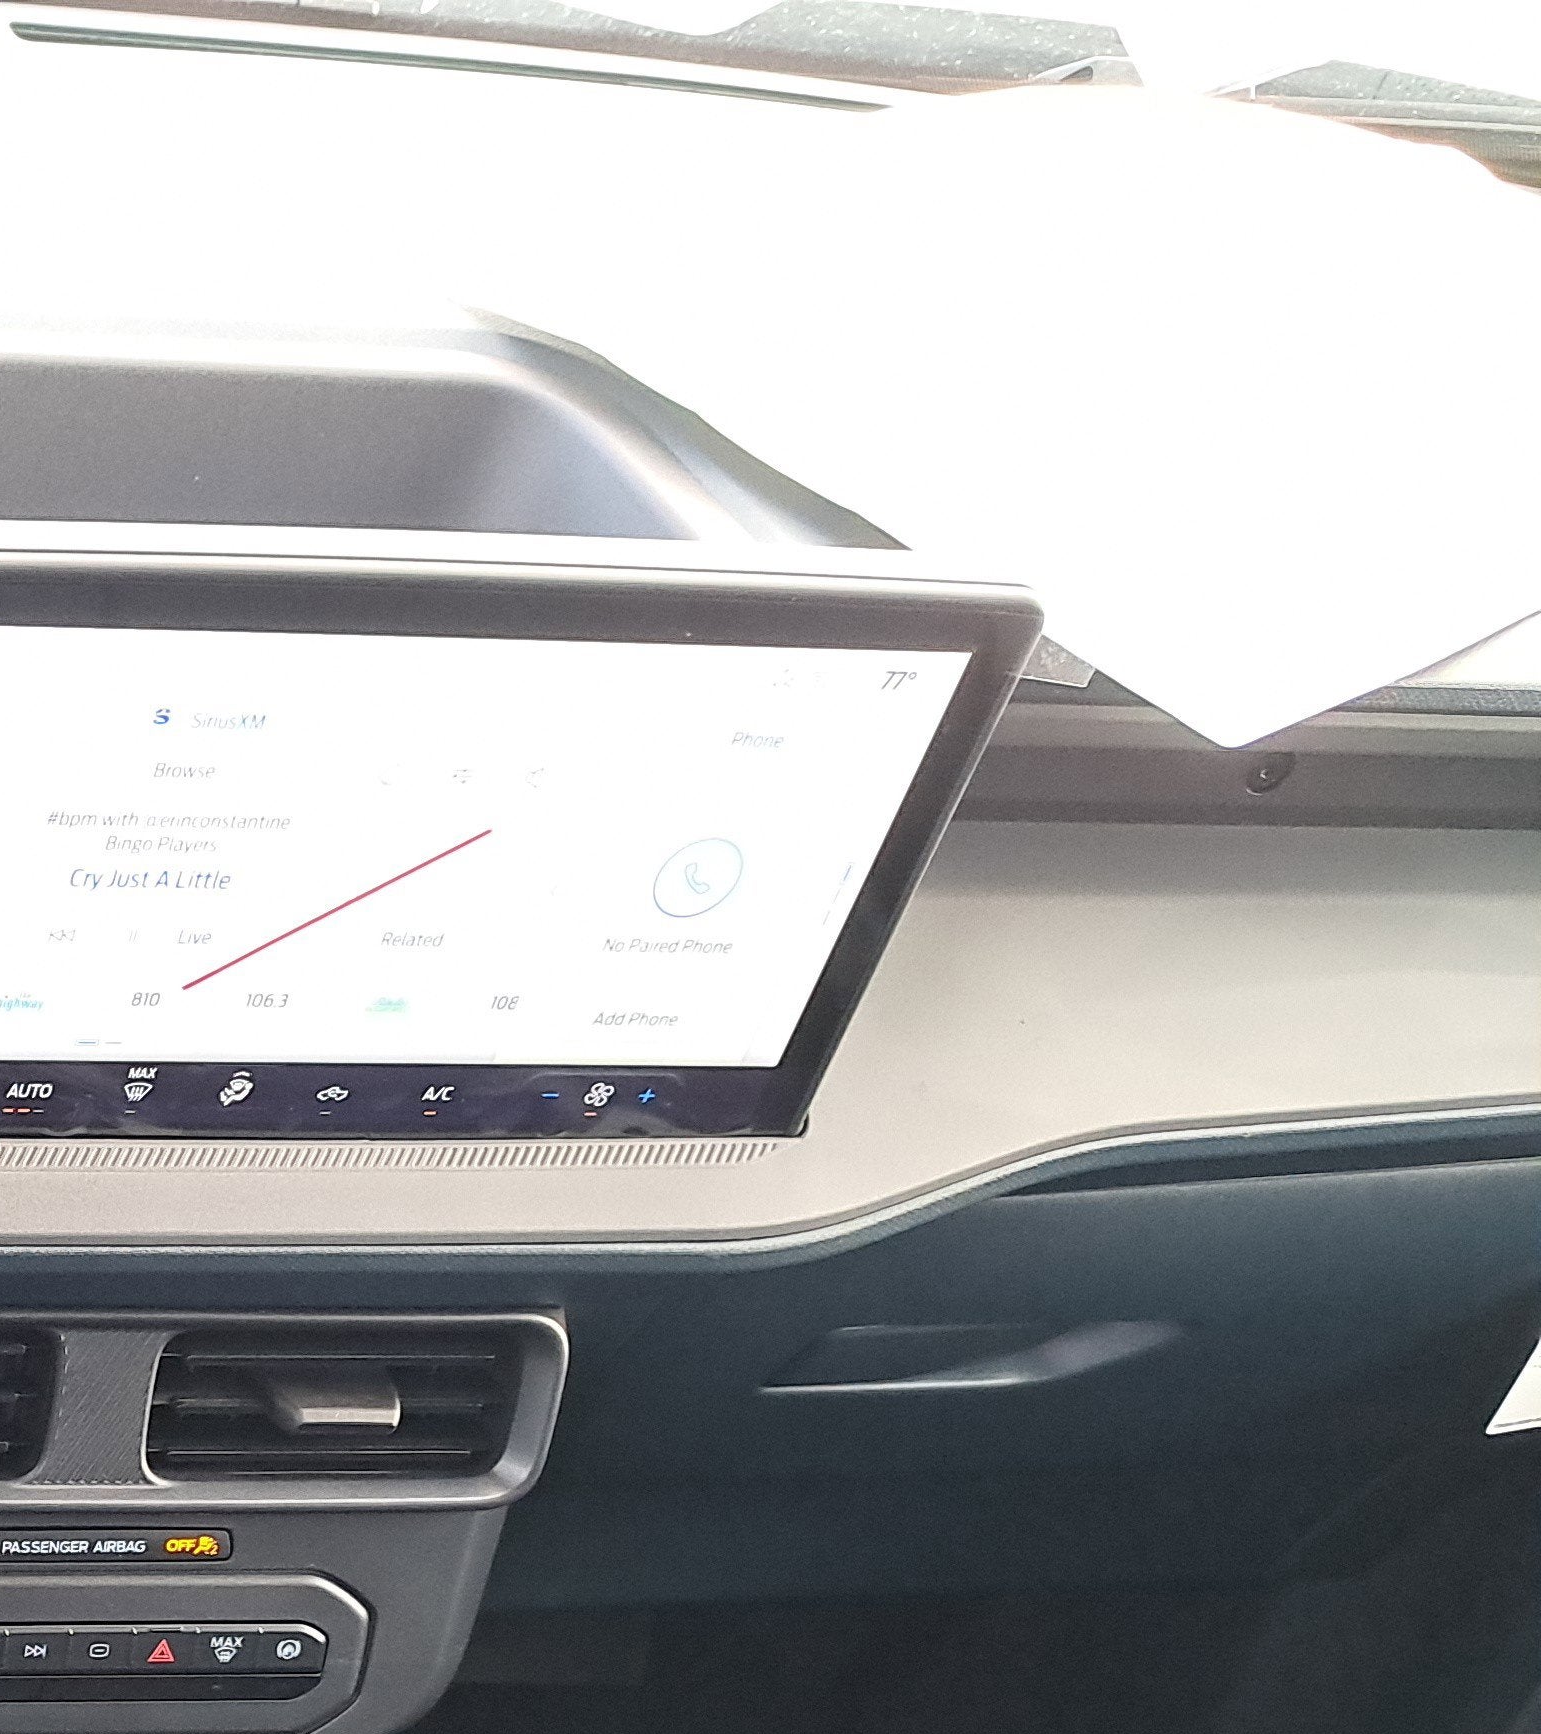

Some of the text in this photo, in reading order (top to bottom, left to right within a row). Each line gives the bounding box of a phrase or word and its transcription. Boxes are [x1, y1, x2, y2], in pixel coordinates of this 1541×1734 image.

[190, 712, 267, 731] SiriusXM
[731, 731, 784, 749] Phone
[152, 762, 216, 779] Browse
[46, 810, 99, 832] #bpm
[102, 812, 139, 830] with
[104, 835, 217, 854] Bingo Players
[69, 868, 232, 891] Cry Just A Little
[177, 927, 213, 946] Live
[380, 931, 445, 948] Related
[601, 938, 734, 956] No Paired Phone
[130, 991, 161, 1007] 810
[244, 992, 289, 1009] 106.3
[592, 1011, 679, 1028] Add Phone
[127, 1066, 158, 1079] MAX
[5, 1083, 53, 1099] AUTO
[421, 1086, 455, 1101] A/C
[1, 1540, 147, 1555] PASSENGER AIRBAG
[166, 1539, 197, 1552] OFF
[210, 1636, 244, 1648] MAX
